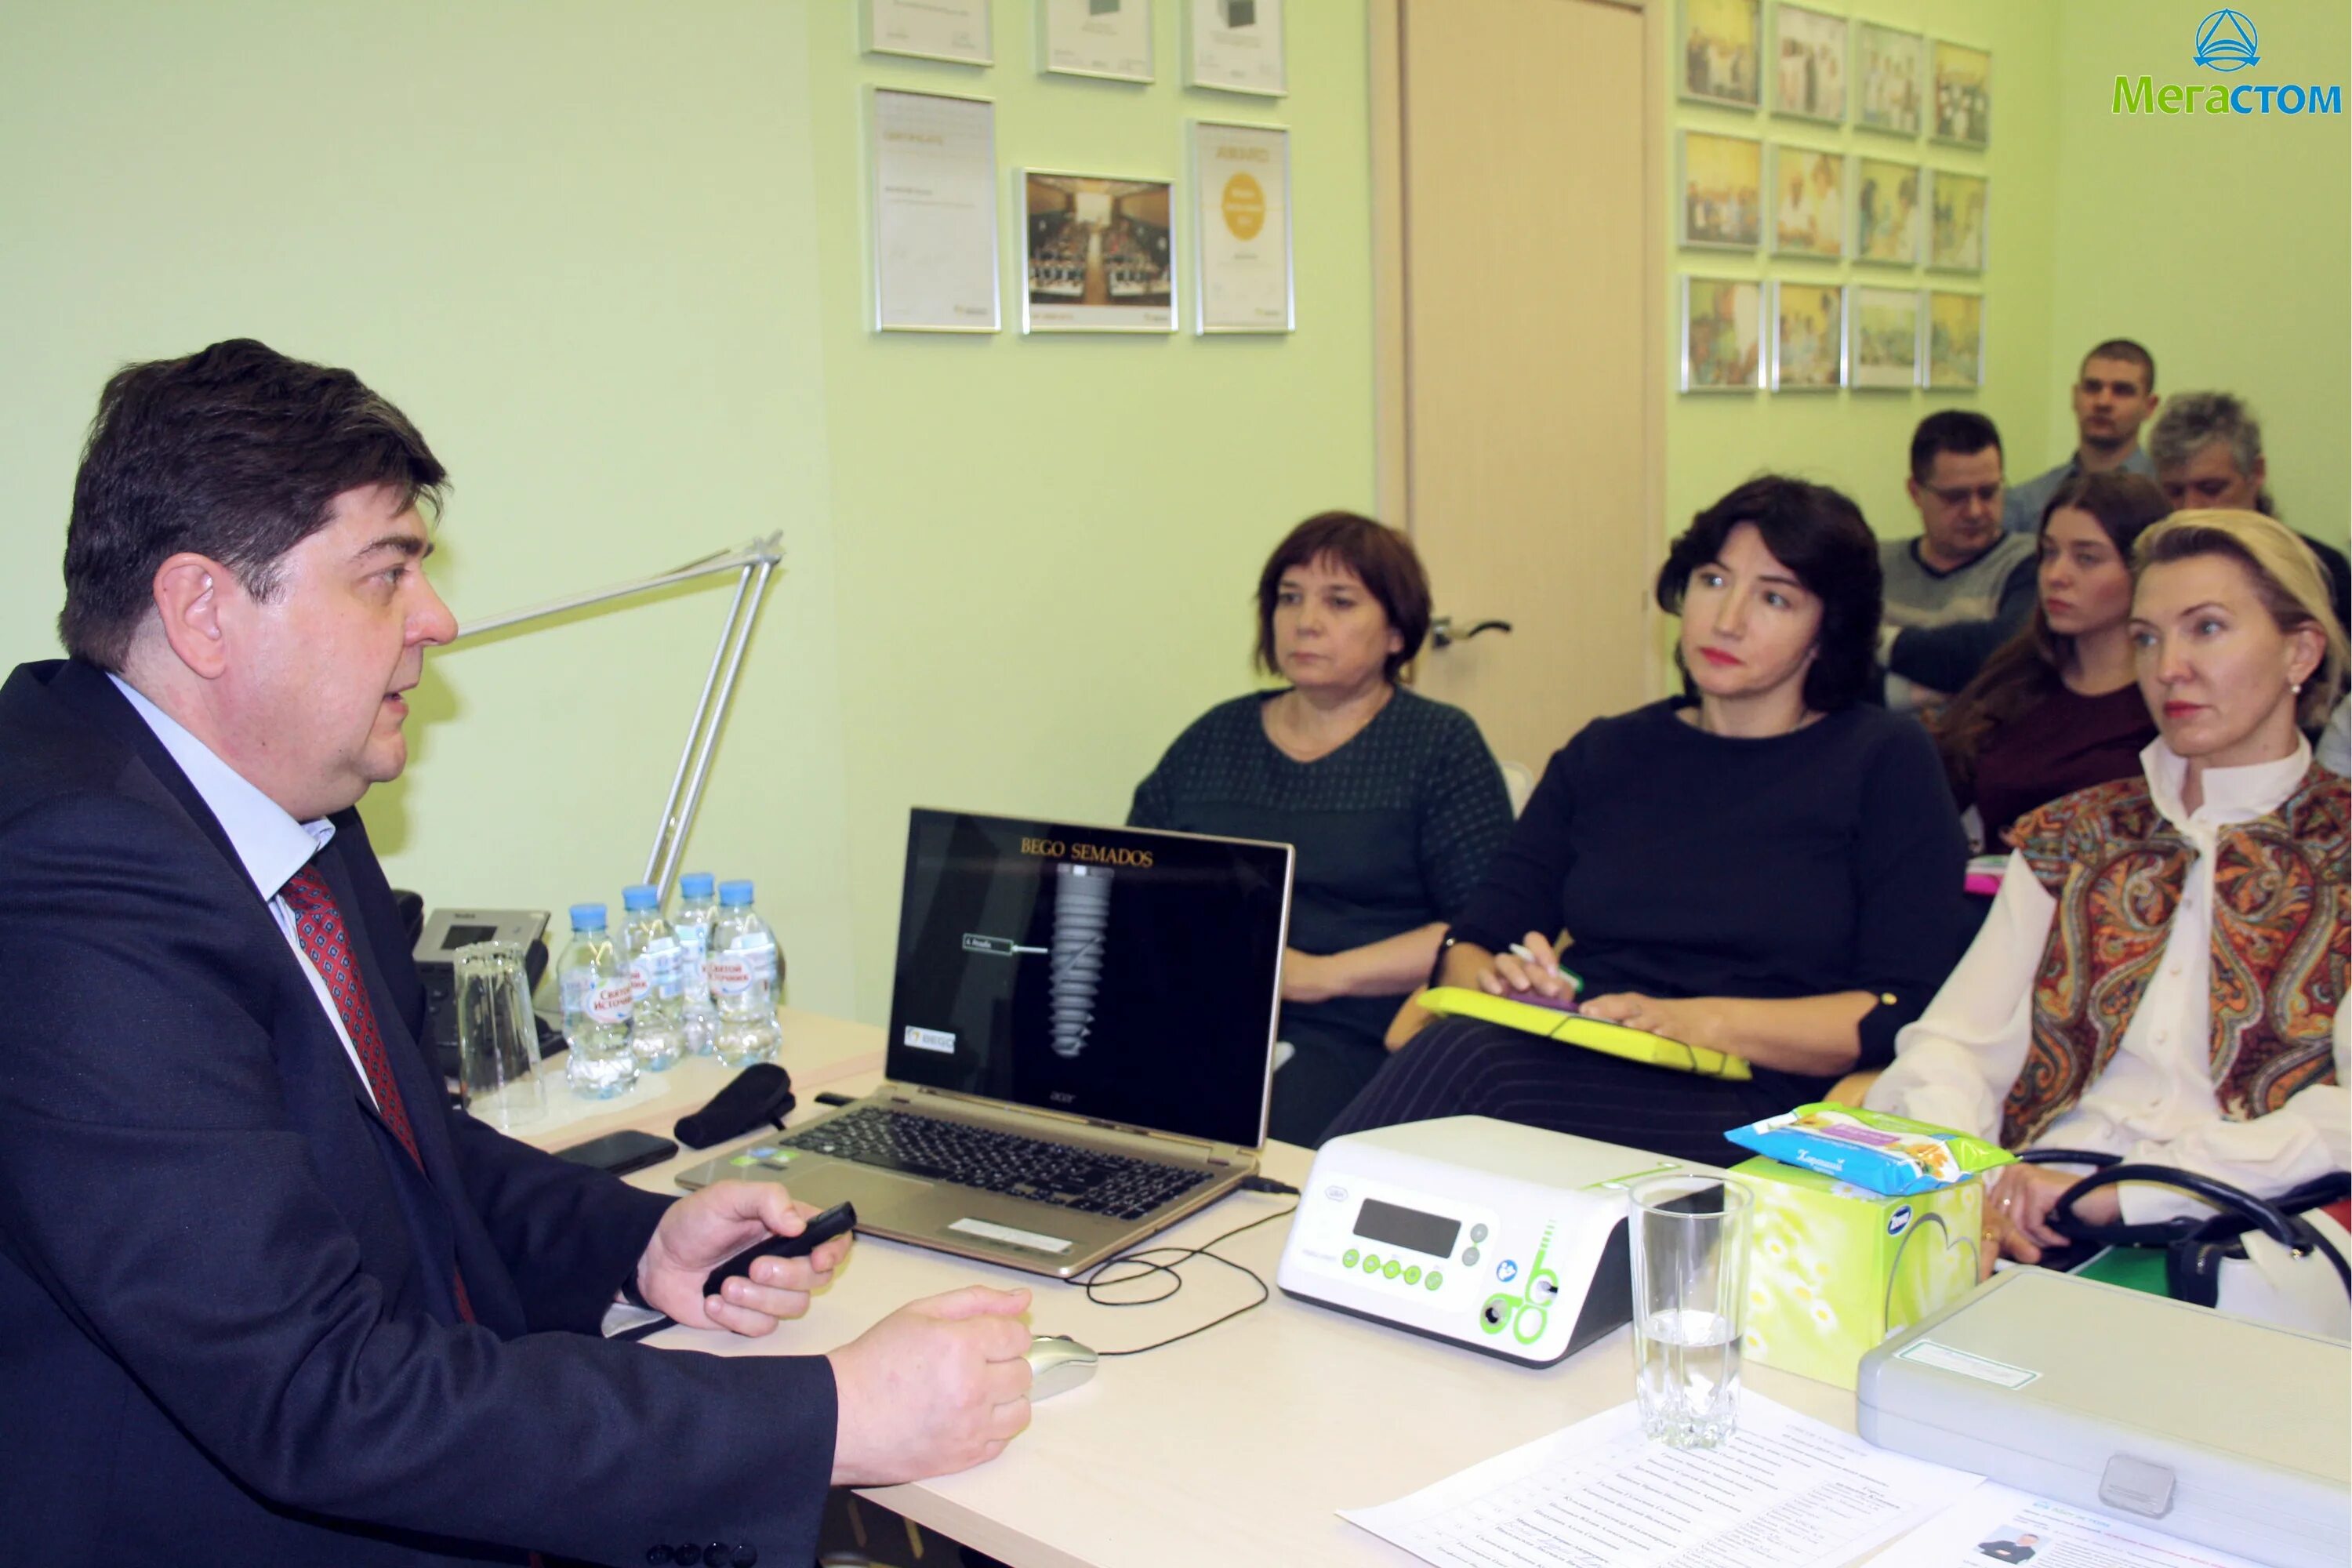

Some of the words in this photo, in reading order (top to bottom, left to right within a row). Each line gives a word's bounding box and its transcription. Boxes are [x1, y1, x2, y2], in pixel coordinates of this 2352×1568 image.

[1021, 837, 1065, 857] BEGO
[1071, 843, 1154, 868] SEMADOS
[1050, 1091, 1076, 1104] acer
